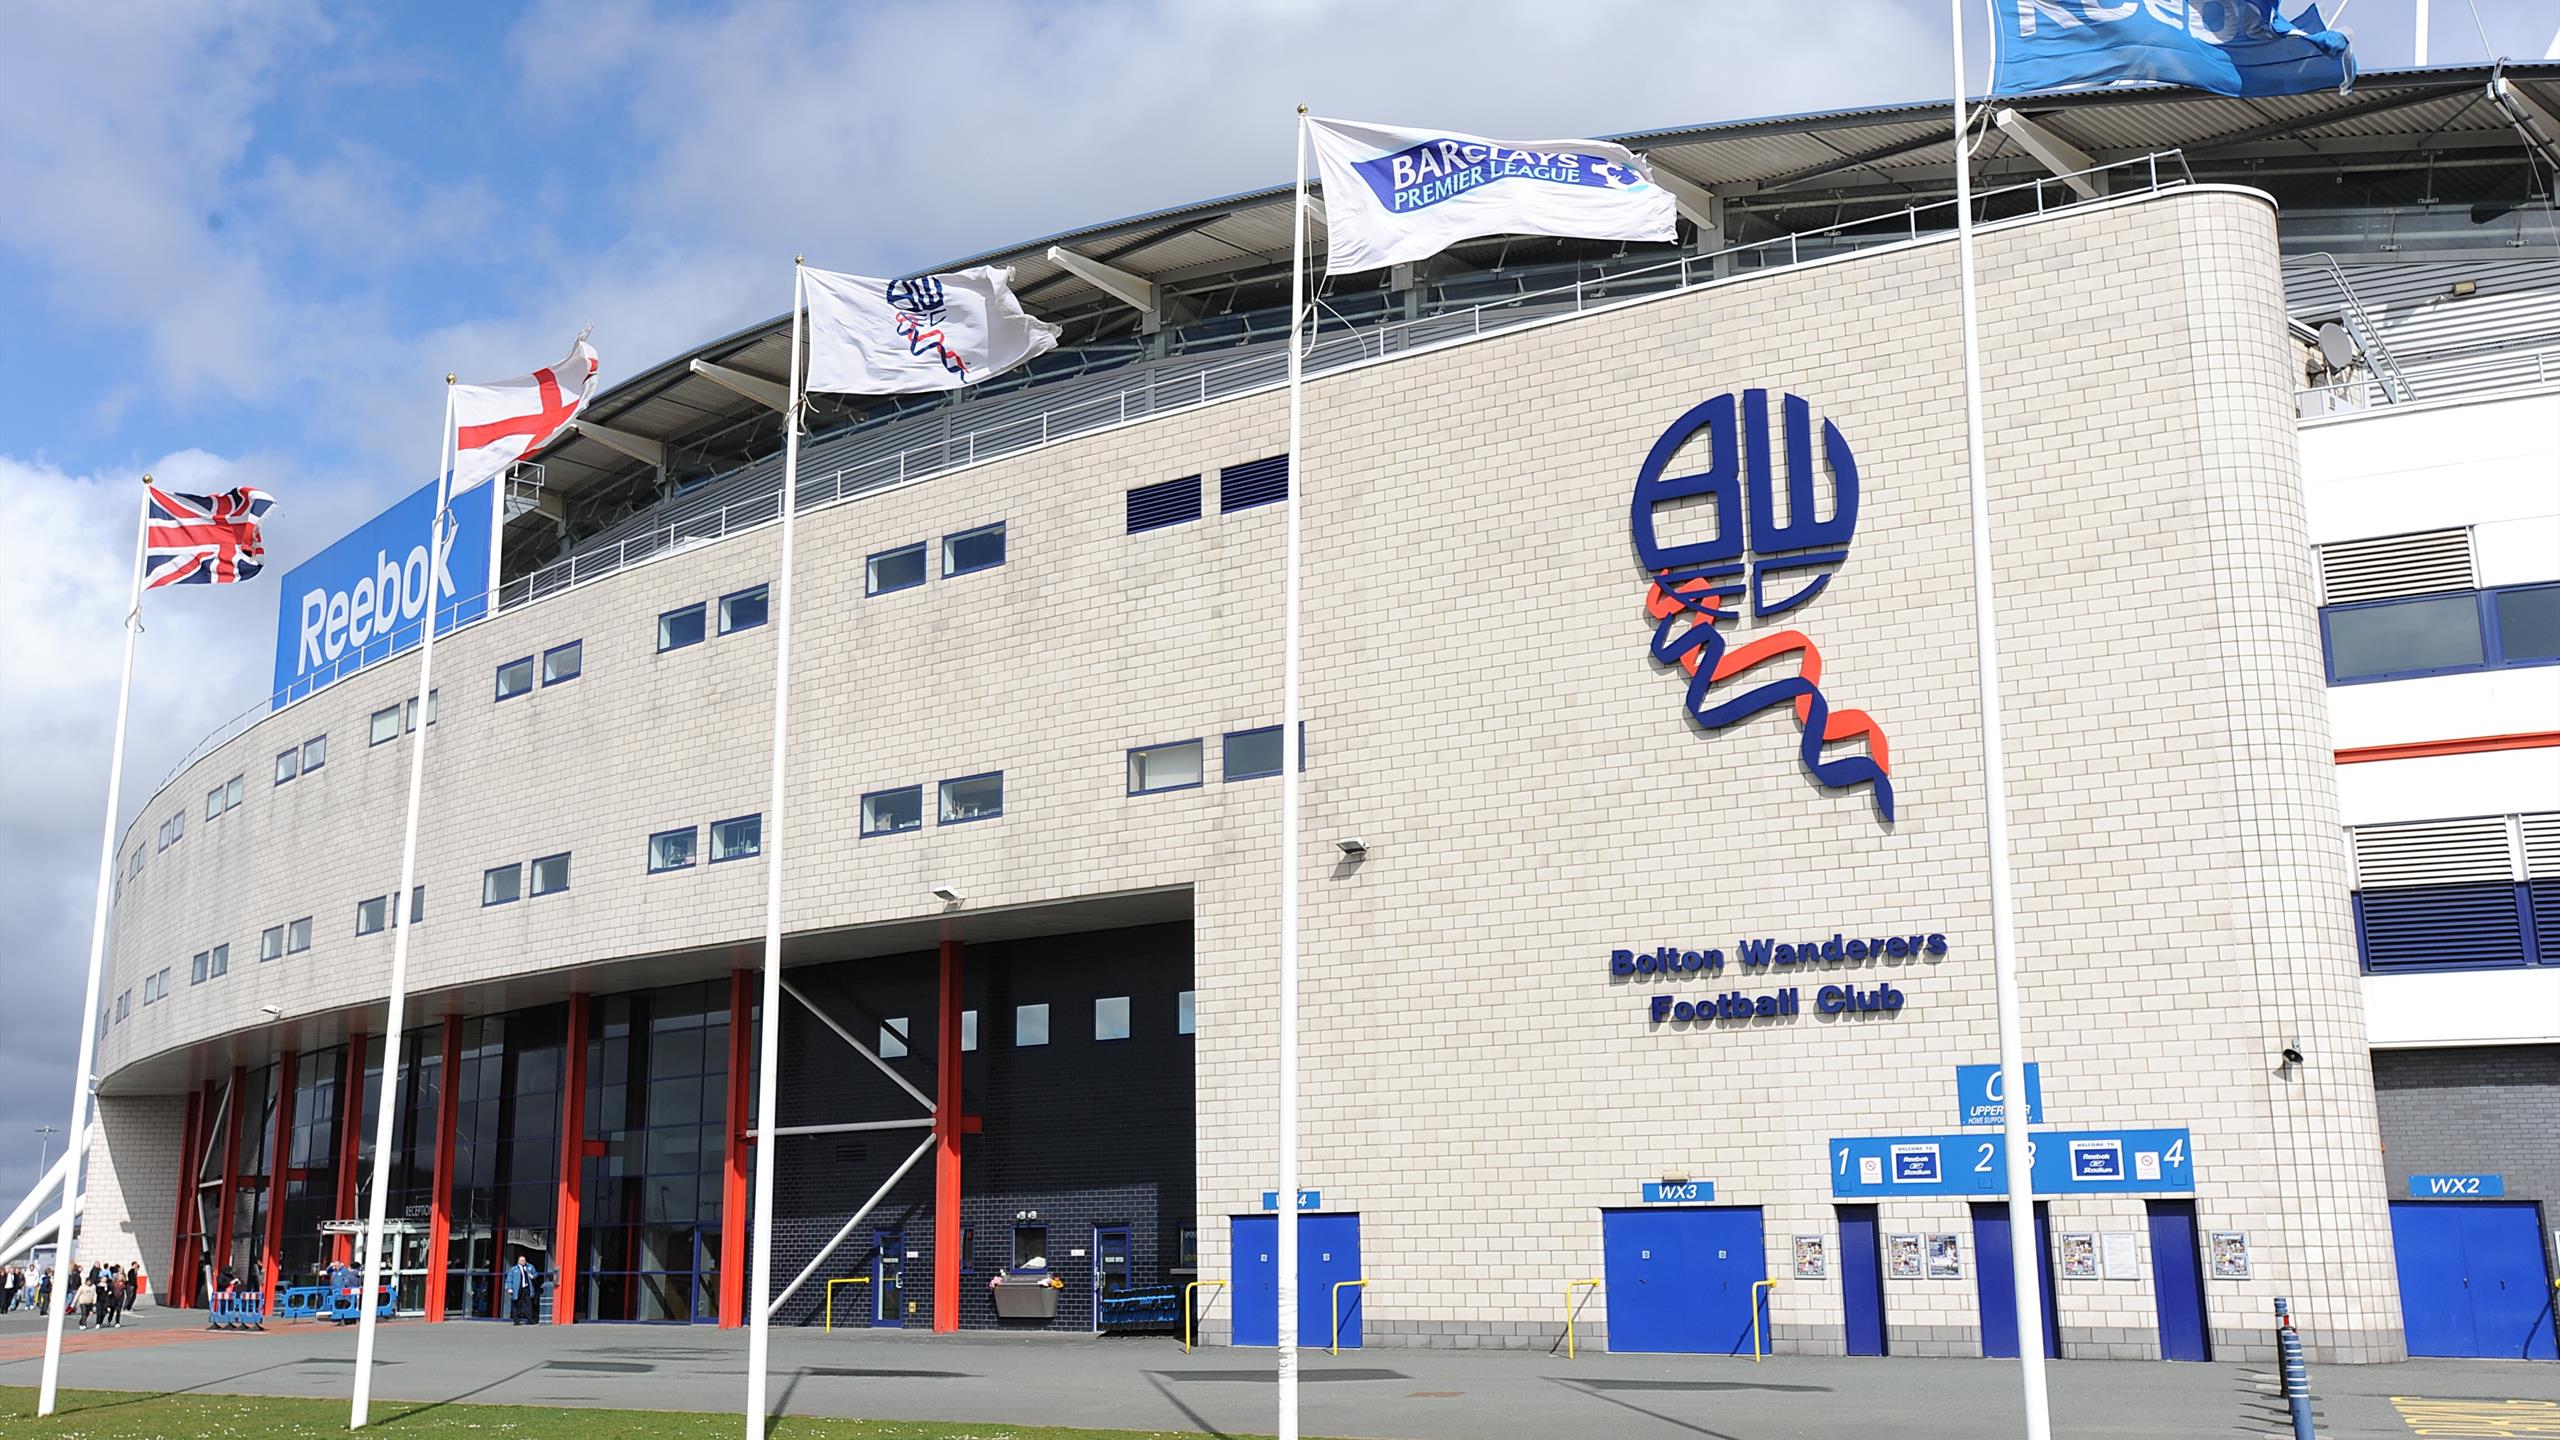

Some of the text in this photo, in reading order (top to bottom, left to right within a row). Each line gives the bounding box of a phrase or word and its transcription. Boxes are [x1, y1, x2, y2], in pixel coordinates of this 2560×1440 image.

[1391, 140, 1580, 190] BARCLAYS
[1394, 160, 1581, 211] PREMIER LEAGUE
[297, 519, 460, 677] Reebok
[1612, 933, 1948, 976] Bolton Wanderers
[1651, 982, 1905, 1023] Football Club
[1970, 1105, 2004, 1117] UPPER
[1838, 1147, 1850, 1175] 1
[1974, 1143, 1995, 1172] 2
[2163, 1138, 2185, 1168] 4
[1658, 1184, 1698, 1200] WX3
[2430, 1177, 2481, 1194] WX2
